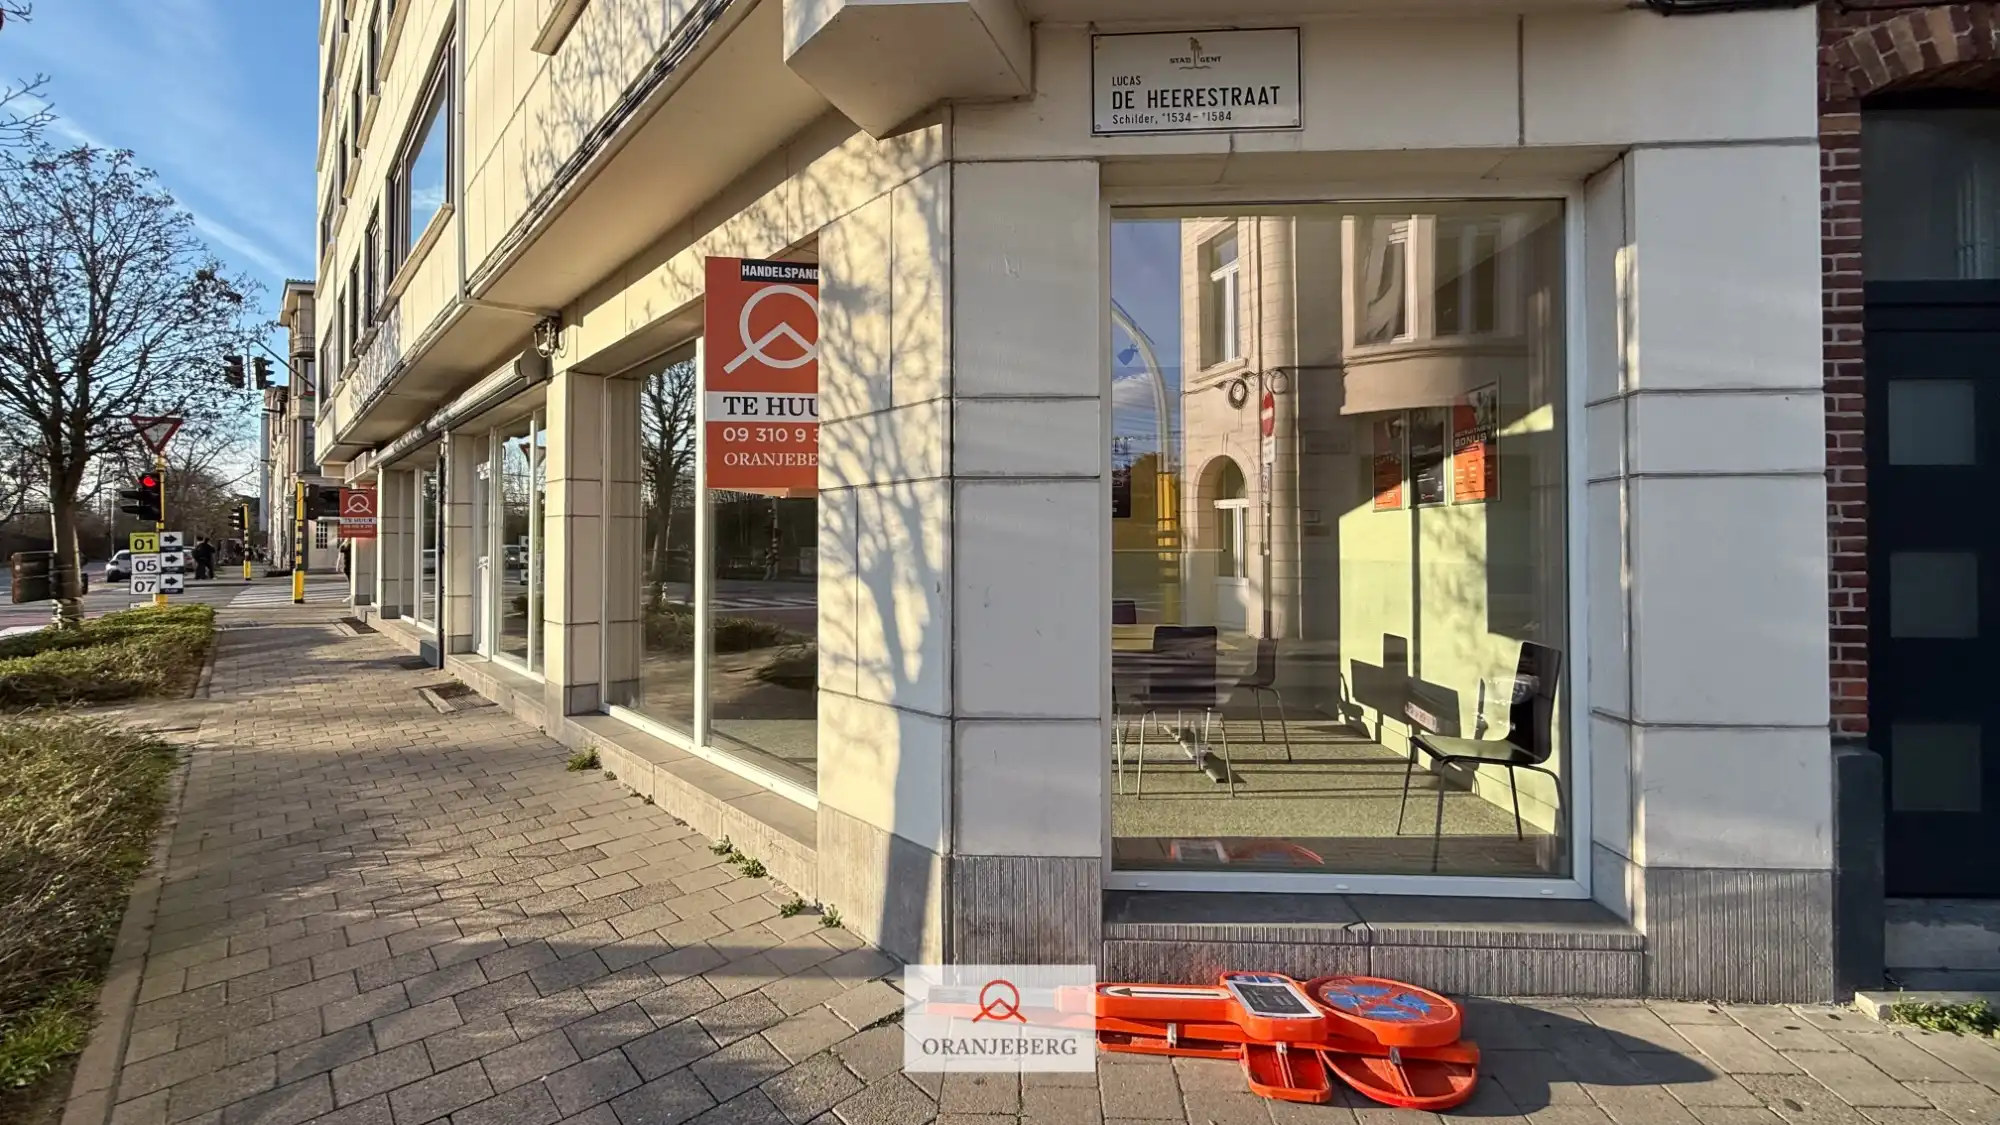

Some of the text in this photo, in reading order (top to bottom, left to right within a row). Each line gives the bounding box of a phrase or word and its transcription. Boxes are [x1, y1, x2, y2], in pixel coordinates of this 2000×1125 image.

[1199, 55, 1222, 63] GENT
[1112, 75, 1142, 86] LUCAS
[1112, 85, 1281, 110] DE HEERESTRAAT
[1112, 114, 1158, 125] Schilder,
[722, 396, 758, 416] TE
[723, 427, 749, 442] 09
[756, 427, 788, 442] 310
[795, 428, 806, 442] 9
[1455, 432, 1487, 447] BONUS
[134, 538, 153, 550] 01
[135, 560, 157, 572] 05
[134, 581, 156, 592] 07
